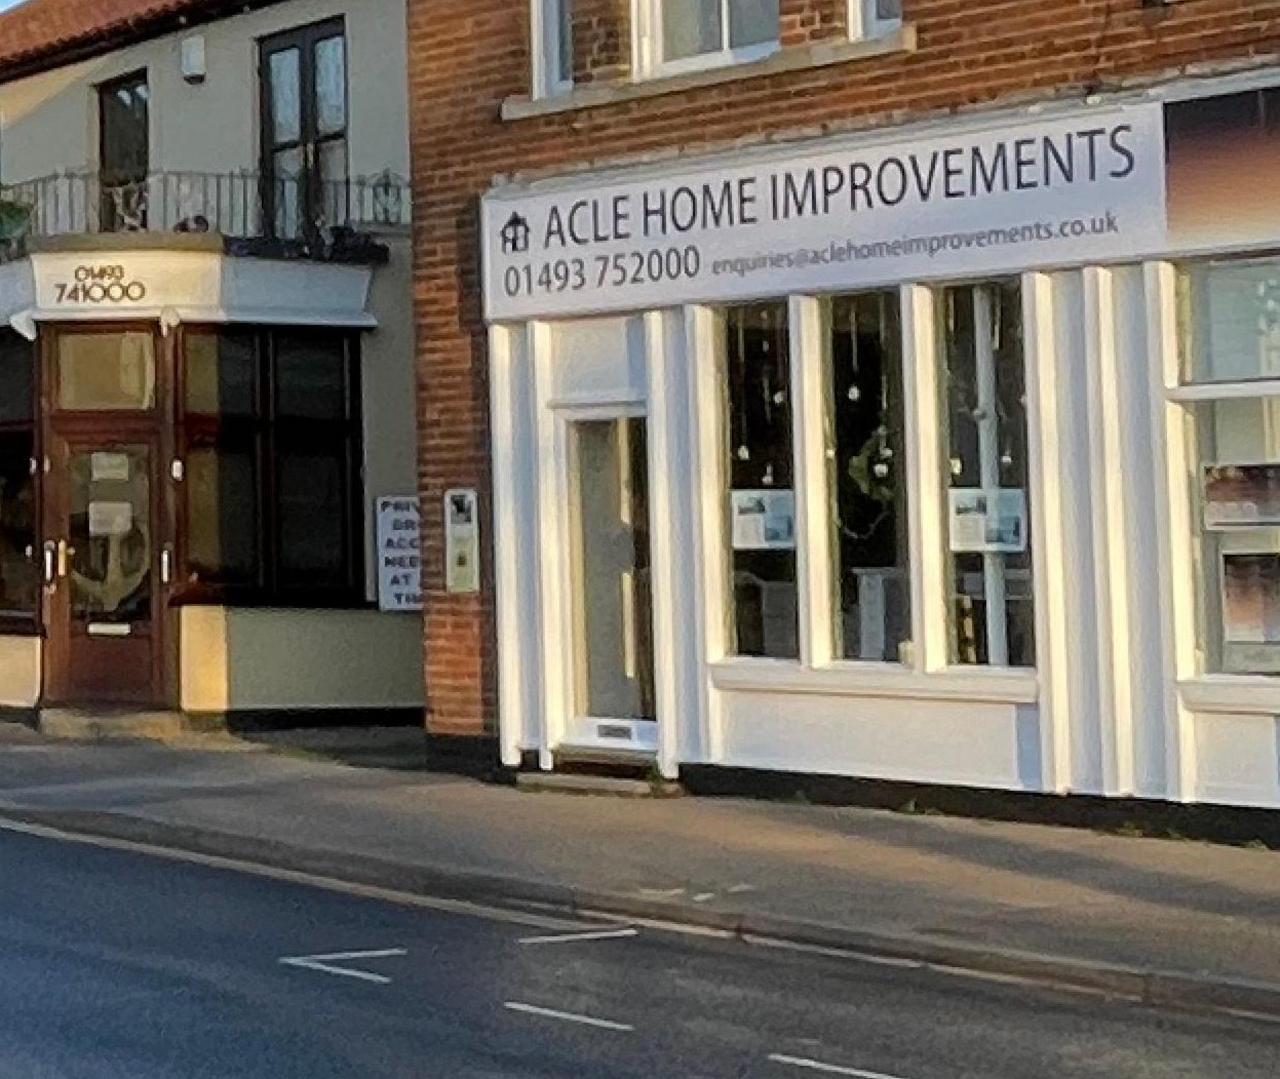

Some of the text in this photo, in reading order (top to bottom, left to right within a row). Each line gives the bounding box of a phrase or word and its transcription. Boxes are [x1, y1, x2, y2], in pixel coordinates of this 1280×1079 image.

[544, 124, 1136, 250] ACLE HOME IMPROVEMENTS
[503, 244, 701, 297] 01493 752000
[711, 210, 1119, 278] enquiries@aclehomeimprovements.co.uk
[54, 281, 146, 303] 741000
